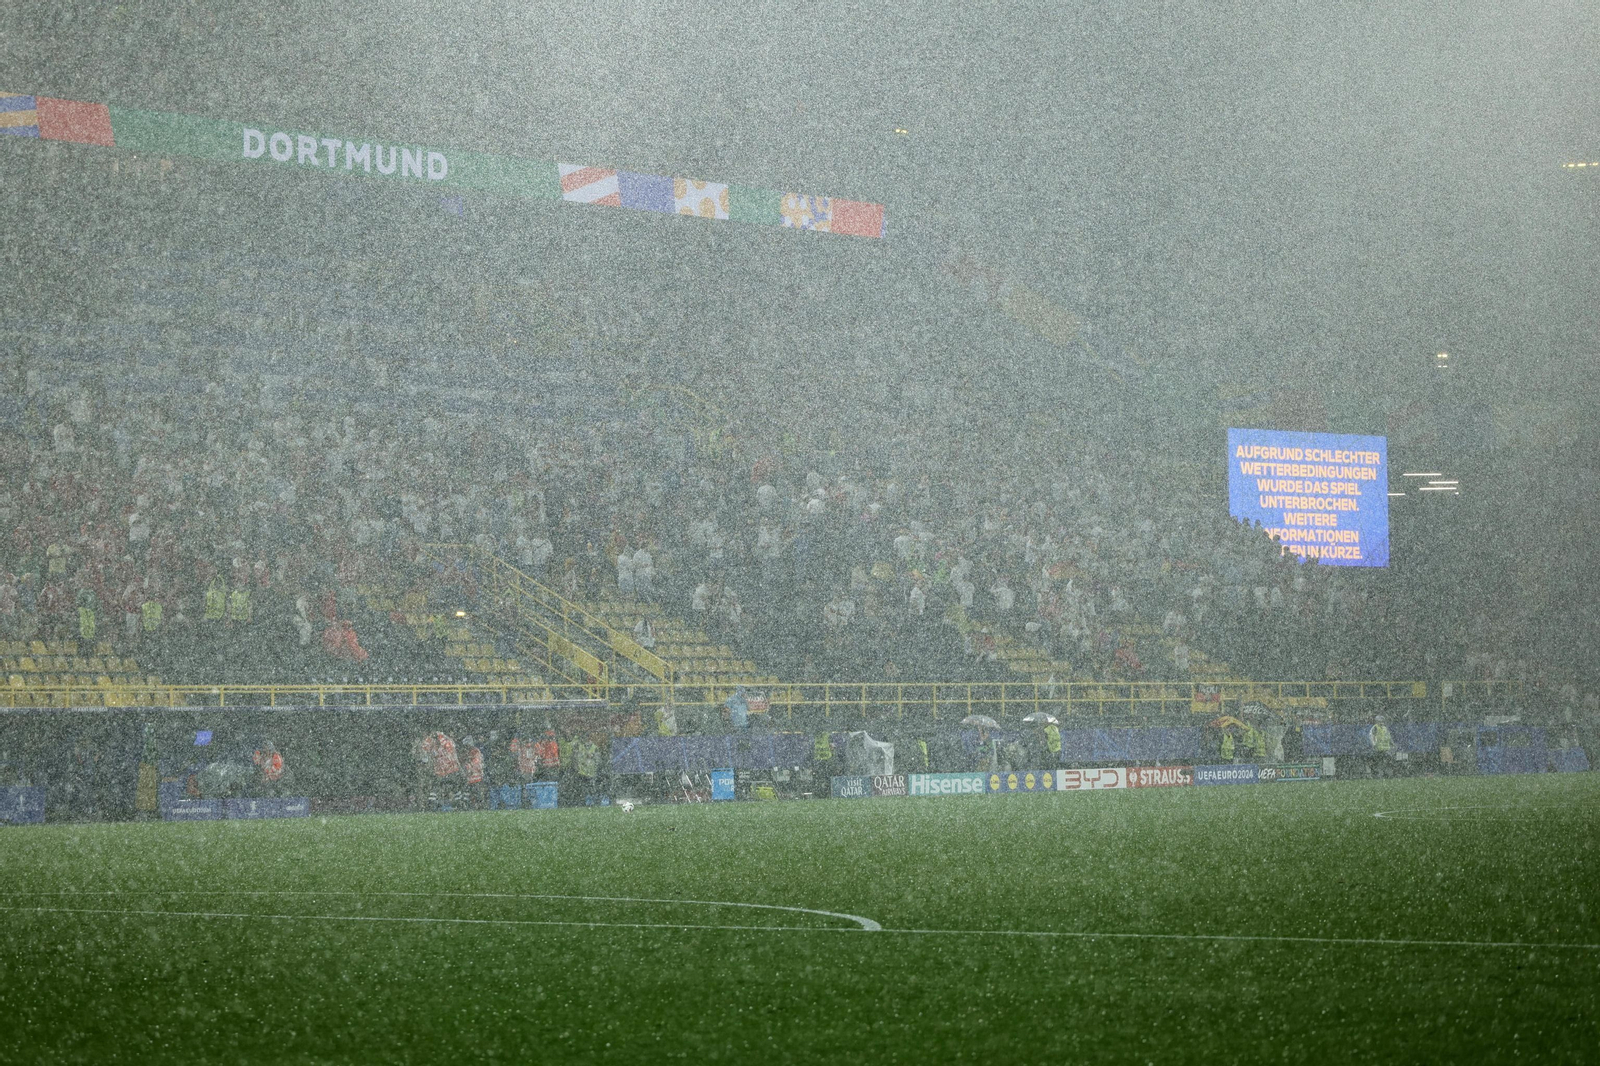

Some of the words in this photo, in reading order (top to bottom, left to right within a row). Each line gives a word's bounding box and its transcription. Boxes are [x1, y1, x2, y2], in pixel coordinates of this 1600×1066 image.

[243, 128, 448, 180] DORTMUND
[1236, 445, 1304, 461] AUFGRUND
[1305, 448, 1380, 465] SCHLECHTER
[1240, 461, 1377, 481] WETTERBEDINGUNGEN
[1257, 478, 1303, 494] WURDE
[1304, 480, 1329, 495] DAS
[1330, 482, 1362, 496] SPIEL
[1260, 495, 1360, 512] UNTERBROCHEN.
[1283, 512, 1338, 527] WEITERE
[1264, 528, 1359, 543] NFORMATIONEN
[1320, 543, 1363, 559] KÜRZE.
[1065, 770, 1119, 789] BYD
[1258, 768, 1276, 779] UEFA
[874, 775, 905, 791] QATAR
[911, 775, 983, 795] Hisense
